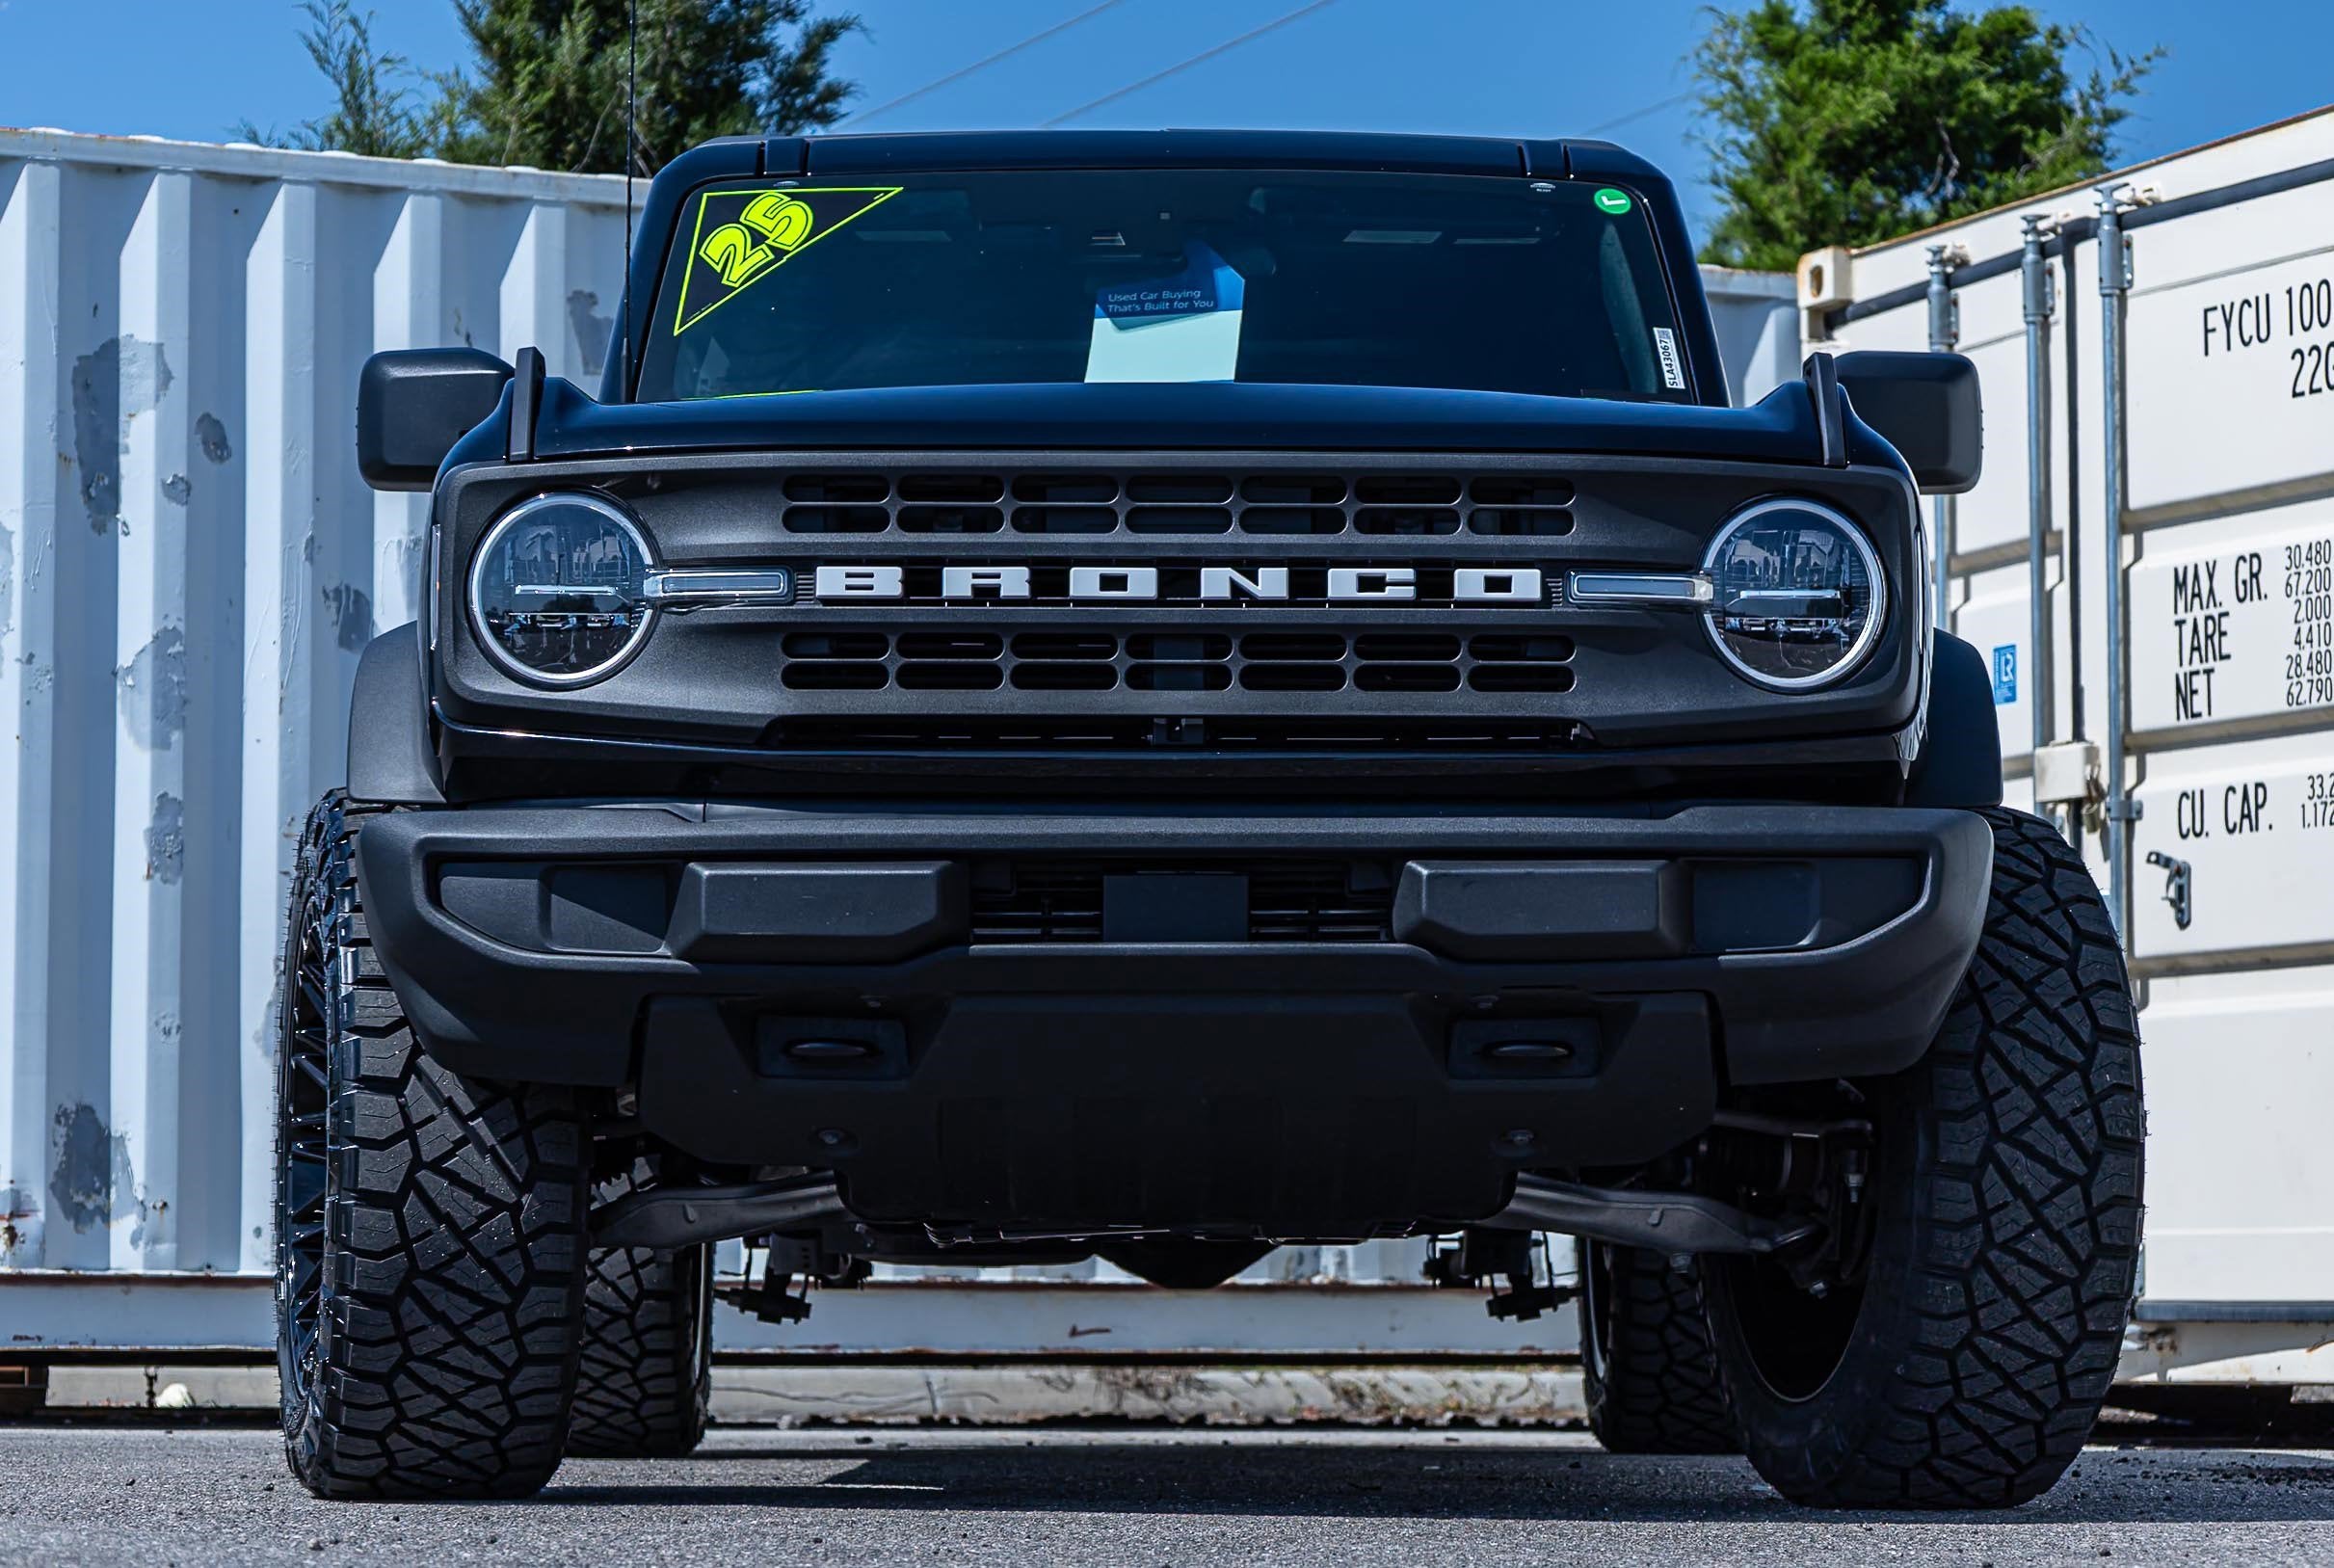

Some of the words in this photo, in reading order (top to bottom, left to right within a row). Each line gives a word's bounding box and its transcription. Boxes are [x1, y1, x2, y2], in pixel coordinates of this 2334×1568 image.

[699, 191, 813, 288] 25
[1108, 292, 1138, 303] Used
[1140, 291, 1158, 301] Car
[1162, 289, 1202, 301] Buying
[1108, 303, 1141, 313] That's
[1144, 301, 1170, 310] Built
[1173, 300, 1189, 309] for
[1193, 299, 1214, 308] You
[2203, 293, 2270, 357] FYCU
[2286, 279, 2332, 336] 100
[1659, 338, 1679, 387] SLA43067
[2285, 539, 2332, 571] 30.480
[814, 565, 1542, 600] BRONCO
[2173, 559, 2223, 615] MAX.
[2234, 552, 2268, 603] GR.
[2285, 567, 2332, 598] 67.200
[2294, 595, 2332, 624] 2.000
[2174, 611, 2232, 667] TARE
[2294, 622, 2332, 651] 4.410
[2286, 649, 2333, 679] 28.480
[2175, 668, 2215, 722] NET
[2286, 677, 2333, 707] 62.790
[2178, 788, 2210, 840] CU.
[2224, 782, 2273, 835] CAP.
